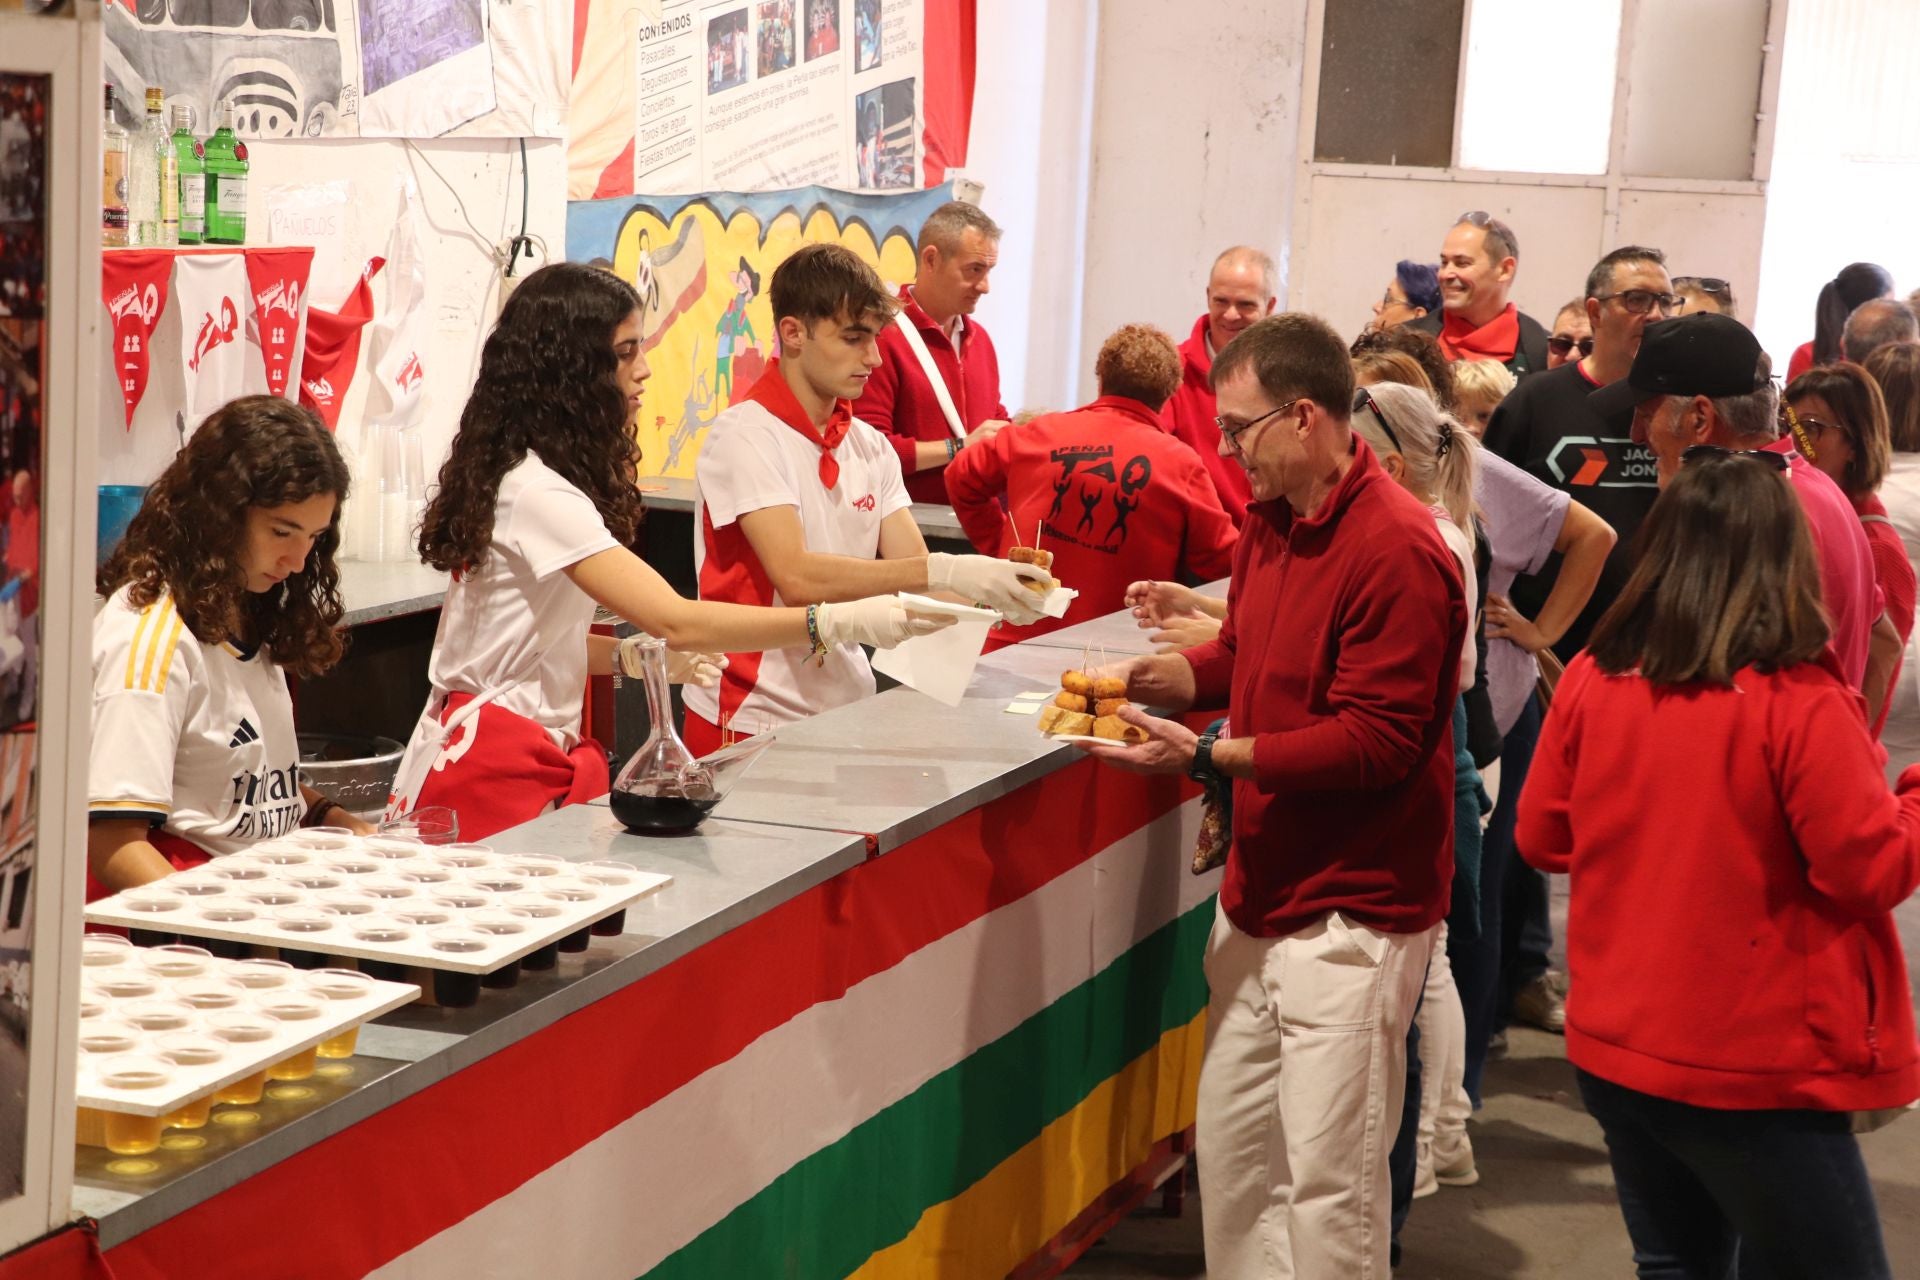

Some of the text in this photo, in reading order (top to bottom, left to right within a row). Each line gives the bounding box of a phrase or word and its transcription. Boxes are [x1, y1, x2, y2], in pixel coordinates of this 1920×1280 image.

[639, 13, 692, 42] CONTENIDOS
[641, 65, 688, 93] Degustaciones
[640, 95, 676, 118] Conciertos
[641, 114, 687, 144] Toros de agua
[640, 133, 697, 169] Fiestas nocturnas
[272, 208, 337, 236] PAÑUELOS
[1623, 449, 1656, 461] JAC
[1620, 464, 1658, 477] JON
